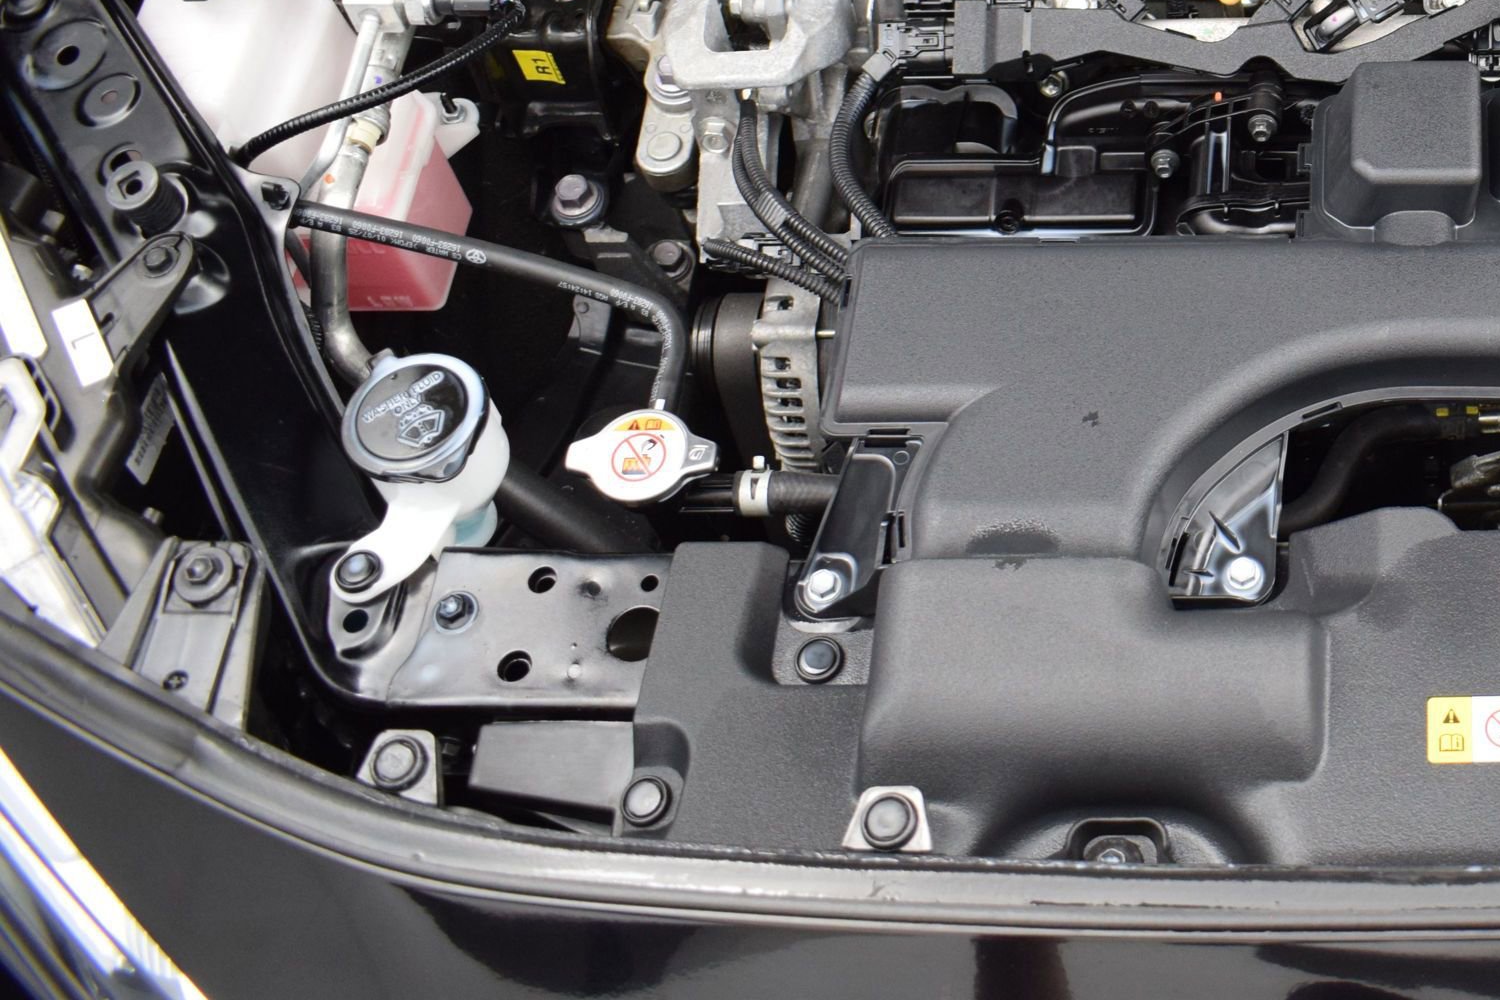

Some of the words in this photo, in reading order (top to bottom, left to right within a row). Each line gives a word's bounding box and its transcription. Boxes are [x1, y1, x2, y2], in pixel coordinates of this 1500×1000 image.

[531, 57, 552, 76] R1
[363, 391, 409, 423] WASHER
[411, 371, 443, 396] FLUID
[394, 395, 422, 415] ONLY
